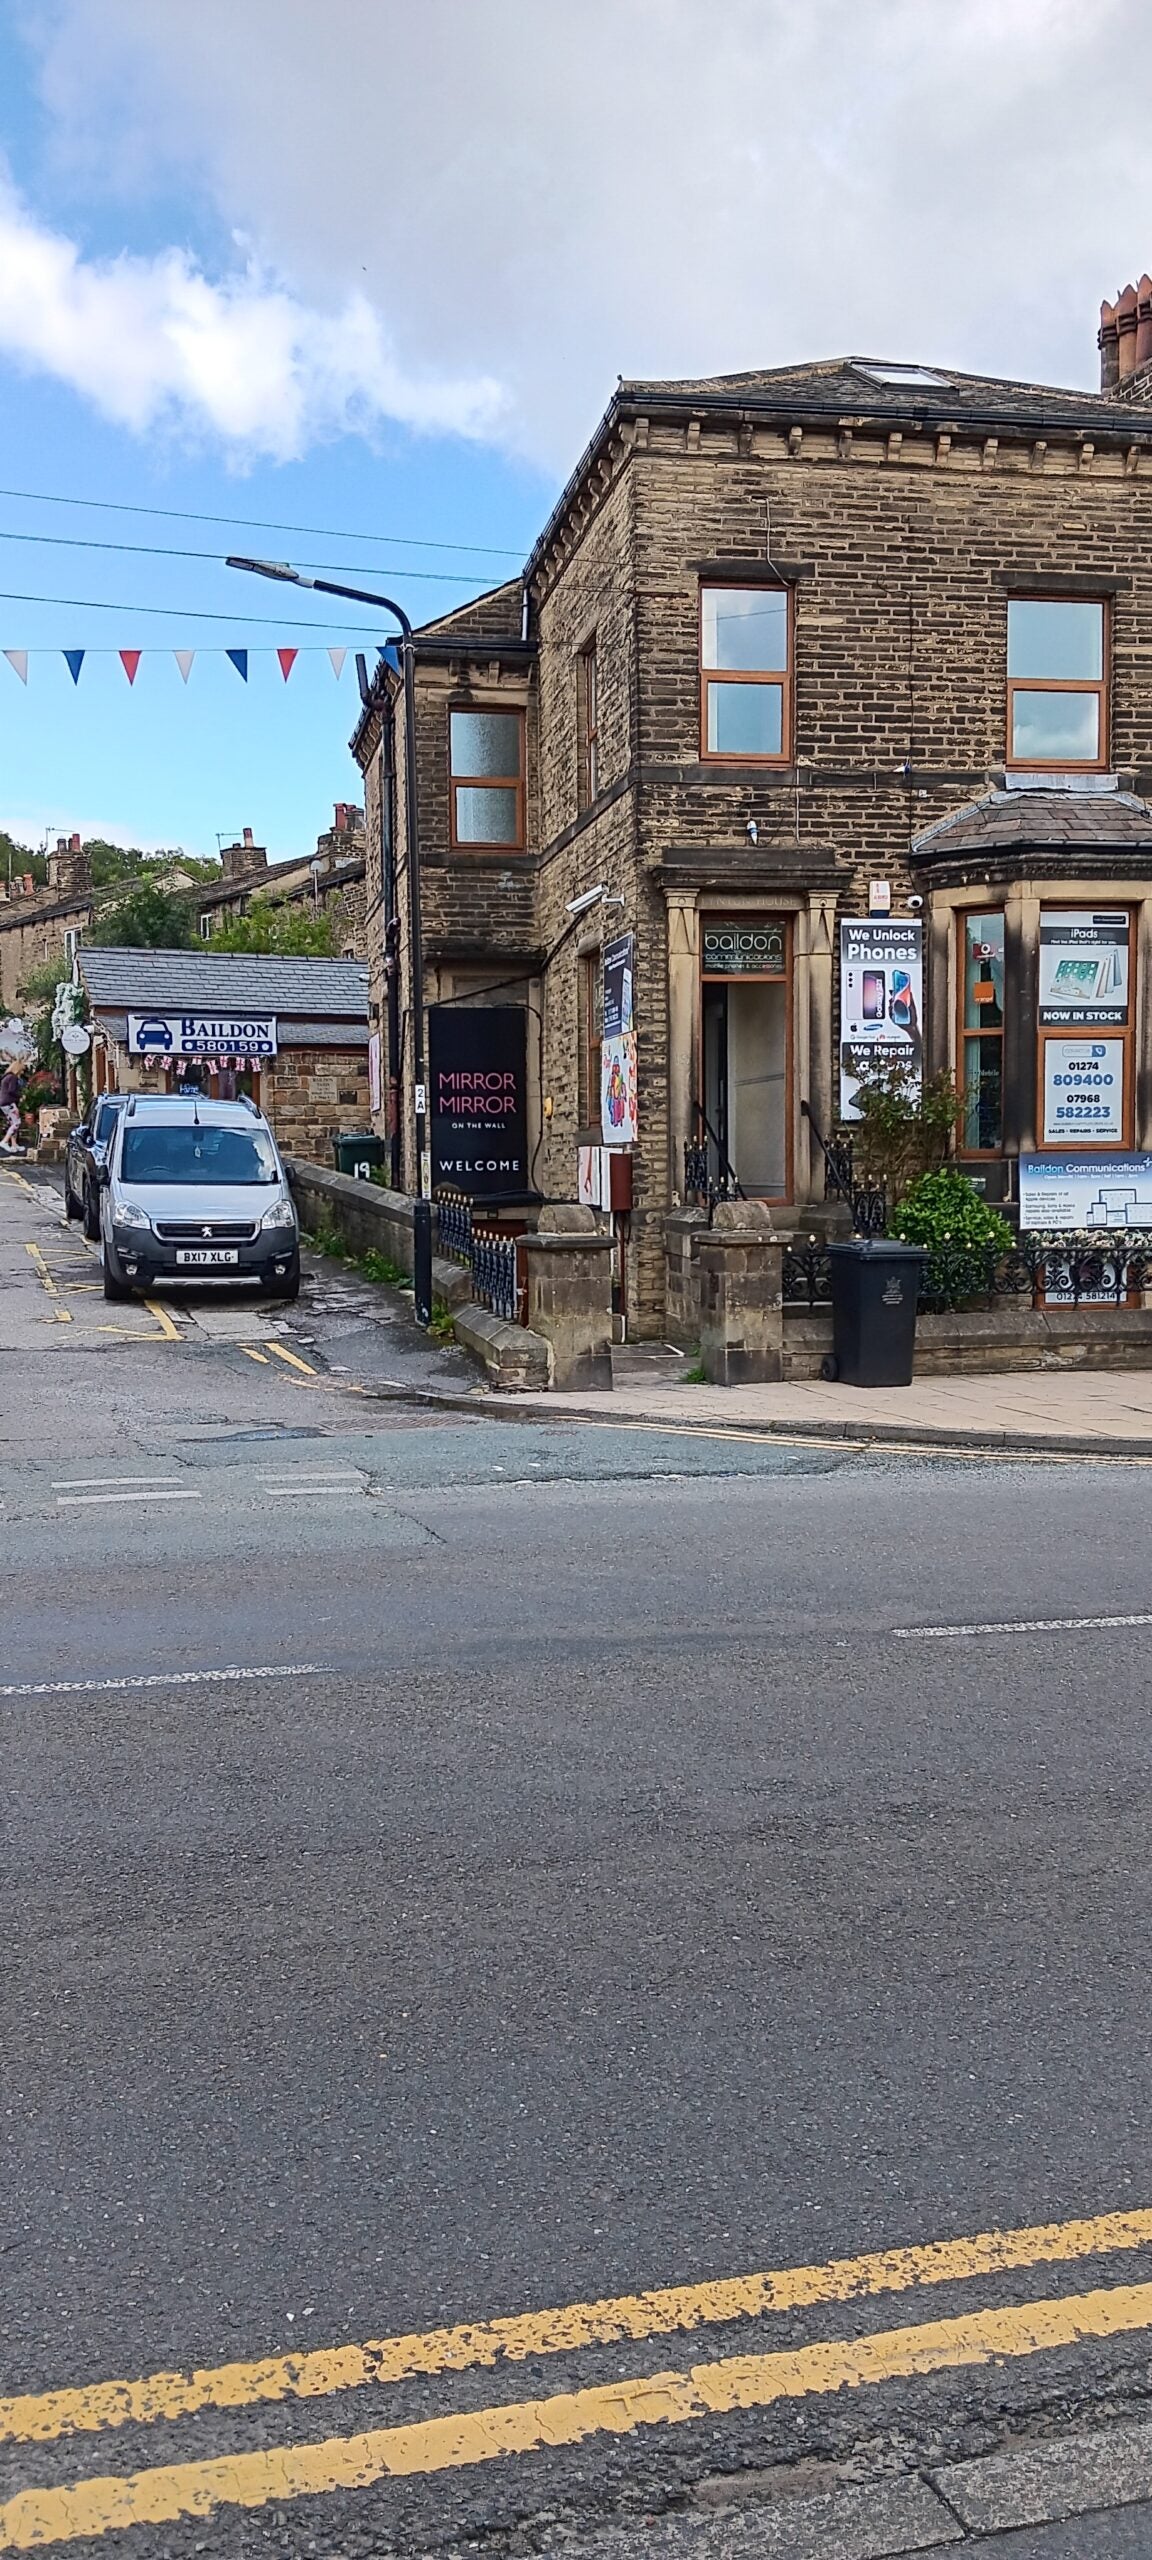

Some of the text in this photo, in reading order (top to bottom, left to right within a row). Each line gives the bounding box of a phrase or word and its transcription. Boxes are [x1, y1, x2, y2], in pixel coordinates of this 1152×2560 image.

[757, 897, 797, 906] HOUSE
[849, 929, 915, 940] We Unlock
[1070, 929, 1098, 938] iPads
[705, 933, 782, 950] baildon
[847, 943, 917, 960] Phones
[1043, 1012, 1122, 1020] NOW IN STOCK
[180, 1019, 269, 1038] BAILDON
[196, 1041, 259, 1051] 580159
[850, 1045, 915, 1058] We Repair
[1068, 1062, 1099, 1071] 01274
[439, 1072, 516, 1090] MIRROR
[1053, 1074, 1114, 1086] 809400
[417, 1088, 424, 1098] 2
[1066, 1094, 1101, 1103] 07968
[417, 1102, 424, 1110] A
[439, 1096, 517, 1113] MIRROR
[1056, 1106, 1110, 1118] 582223
[354, 1161, 370, 1179] 19
[440, 1160, 519, 1172] WELCOME
[1027, 1163, 1145, 1174] Baildon Communications
[184, 1252, 231, 1262] BX17 XLG
[1056, 1292, 1116, 1301] 012 581214
